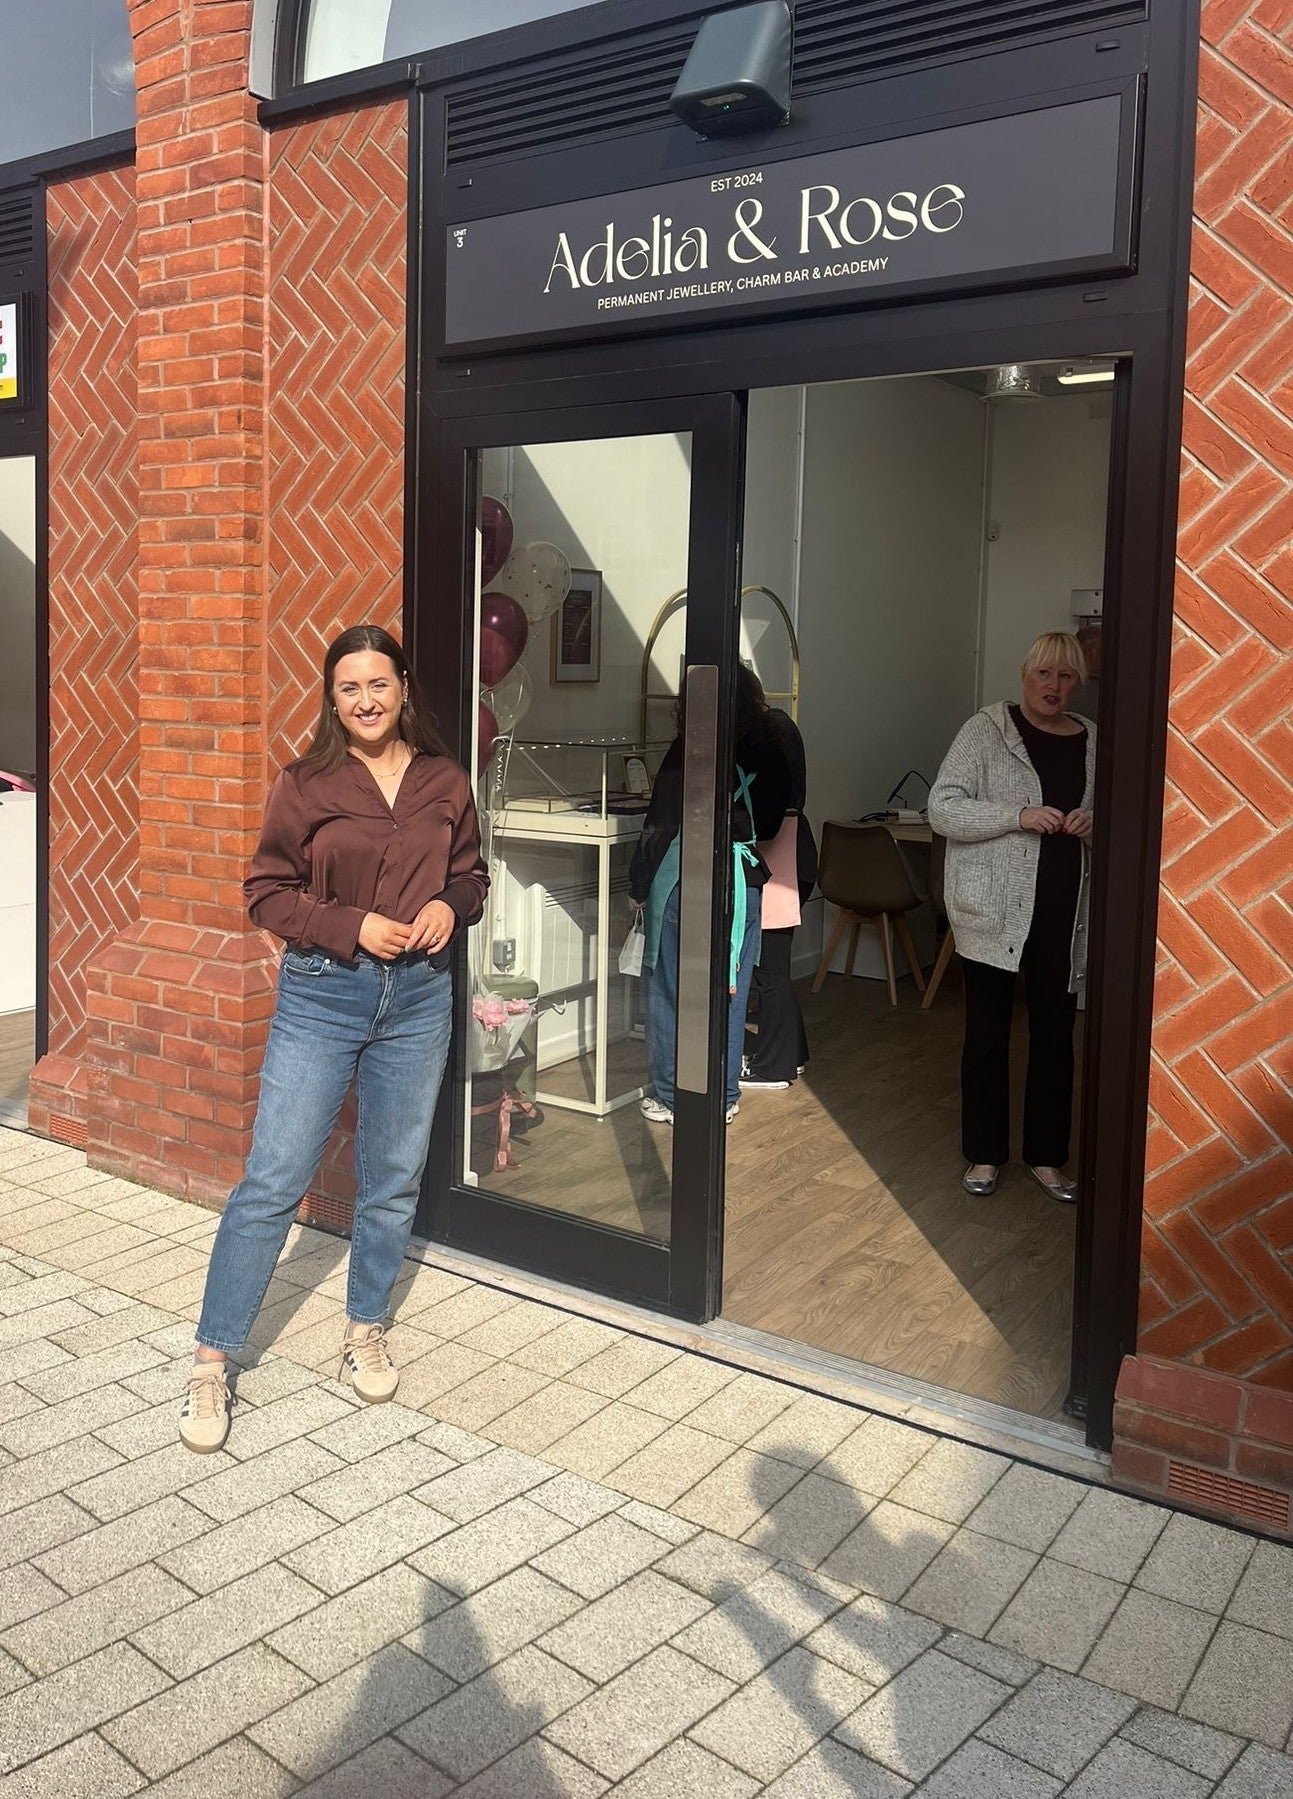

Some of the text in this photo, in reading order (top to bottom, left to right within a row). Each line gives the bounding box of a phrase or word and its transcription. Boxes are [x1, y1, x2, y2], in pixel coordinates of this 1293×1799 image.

[710, 171, 764, 193] EST 2024
[453, 228, 467, 238] UNIT
[456, 236, 464, 248] 3
[542, 183, 966, 294] Adelia & Rose
[597, 256, 889, 310] PERMANENT JEWELLERY, CHARM BAR & ACADEMY
